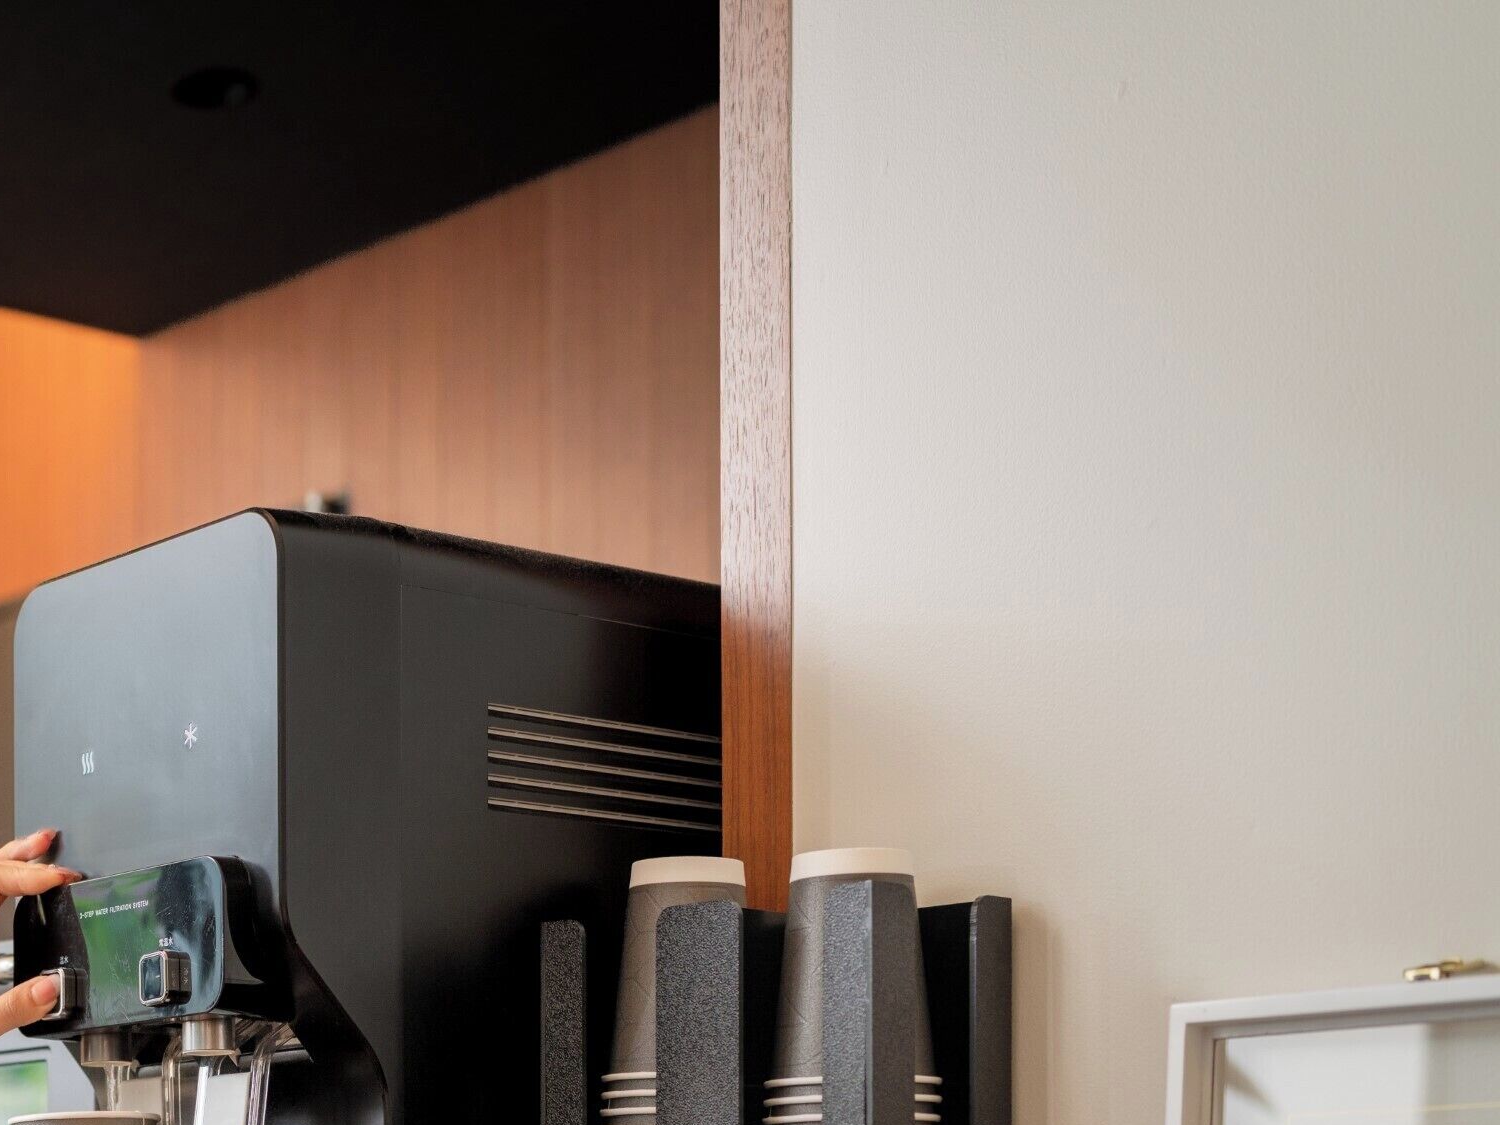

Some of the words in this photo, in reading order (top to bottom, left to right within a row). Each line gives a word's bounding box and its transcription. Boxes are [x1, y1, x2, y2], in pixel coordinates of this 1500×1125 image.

[95, 907, 108, 916] WATER
[110, 903, 132, 914] FILTRATION
[133, 900, 149, 909] SYSTEM
